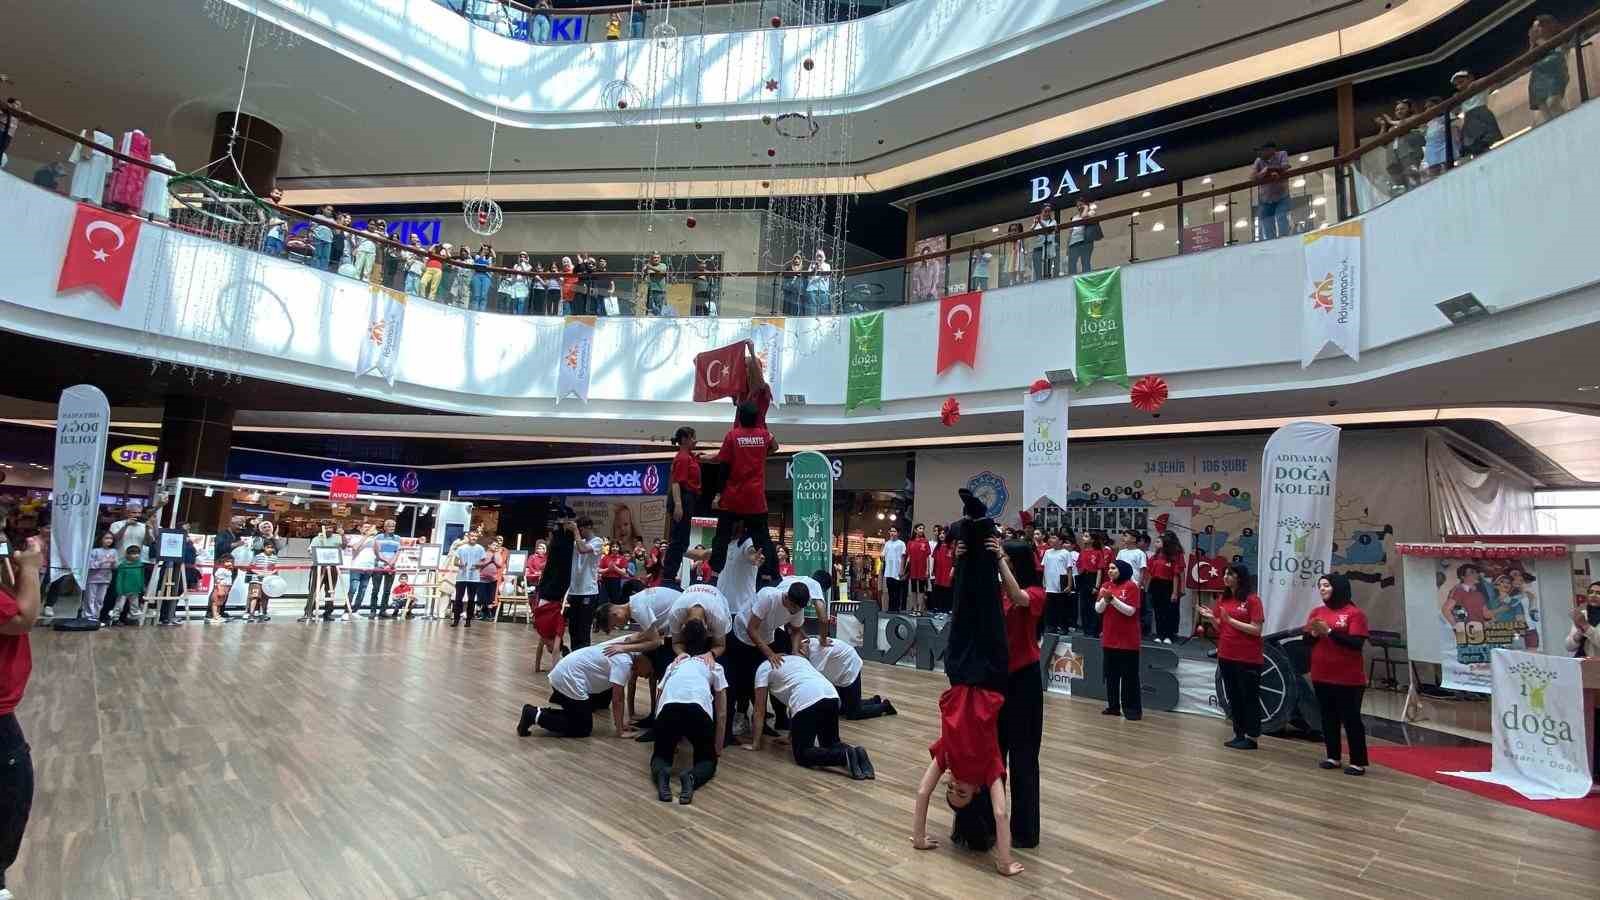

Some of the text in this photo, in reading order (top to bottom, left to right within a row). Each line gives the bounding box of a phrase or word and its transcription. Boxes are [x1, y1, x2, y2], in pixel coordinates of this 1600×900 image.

[1029, 145, 1165, 204] BATİK
[1277, 454, 1333, 464] ADIYAMAN
[587, 470, 641, 488] ebebek
[1275, 465, 1331, 482] DOĞA
[1274, 482, 1330, 497] KOLEJİ
